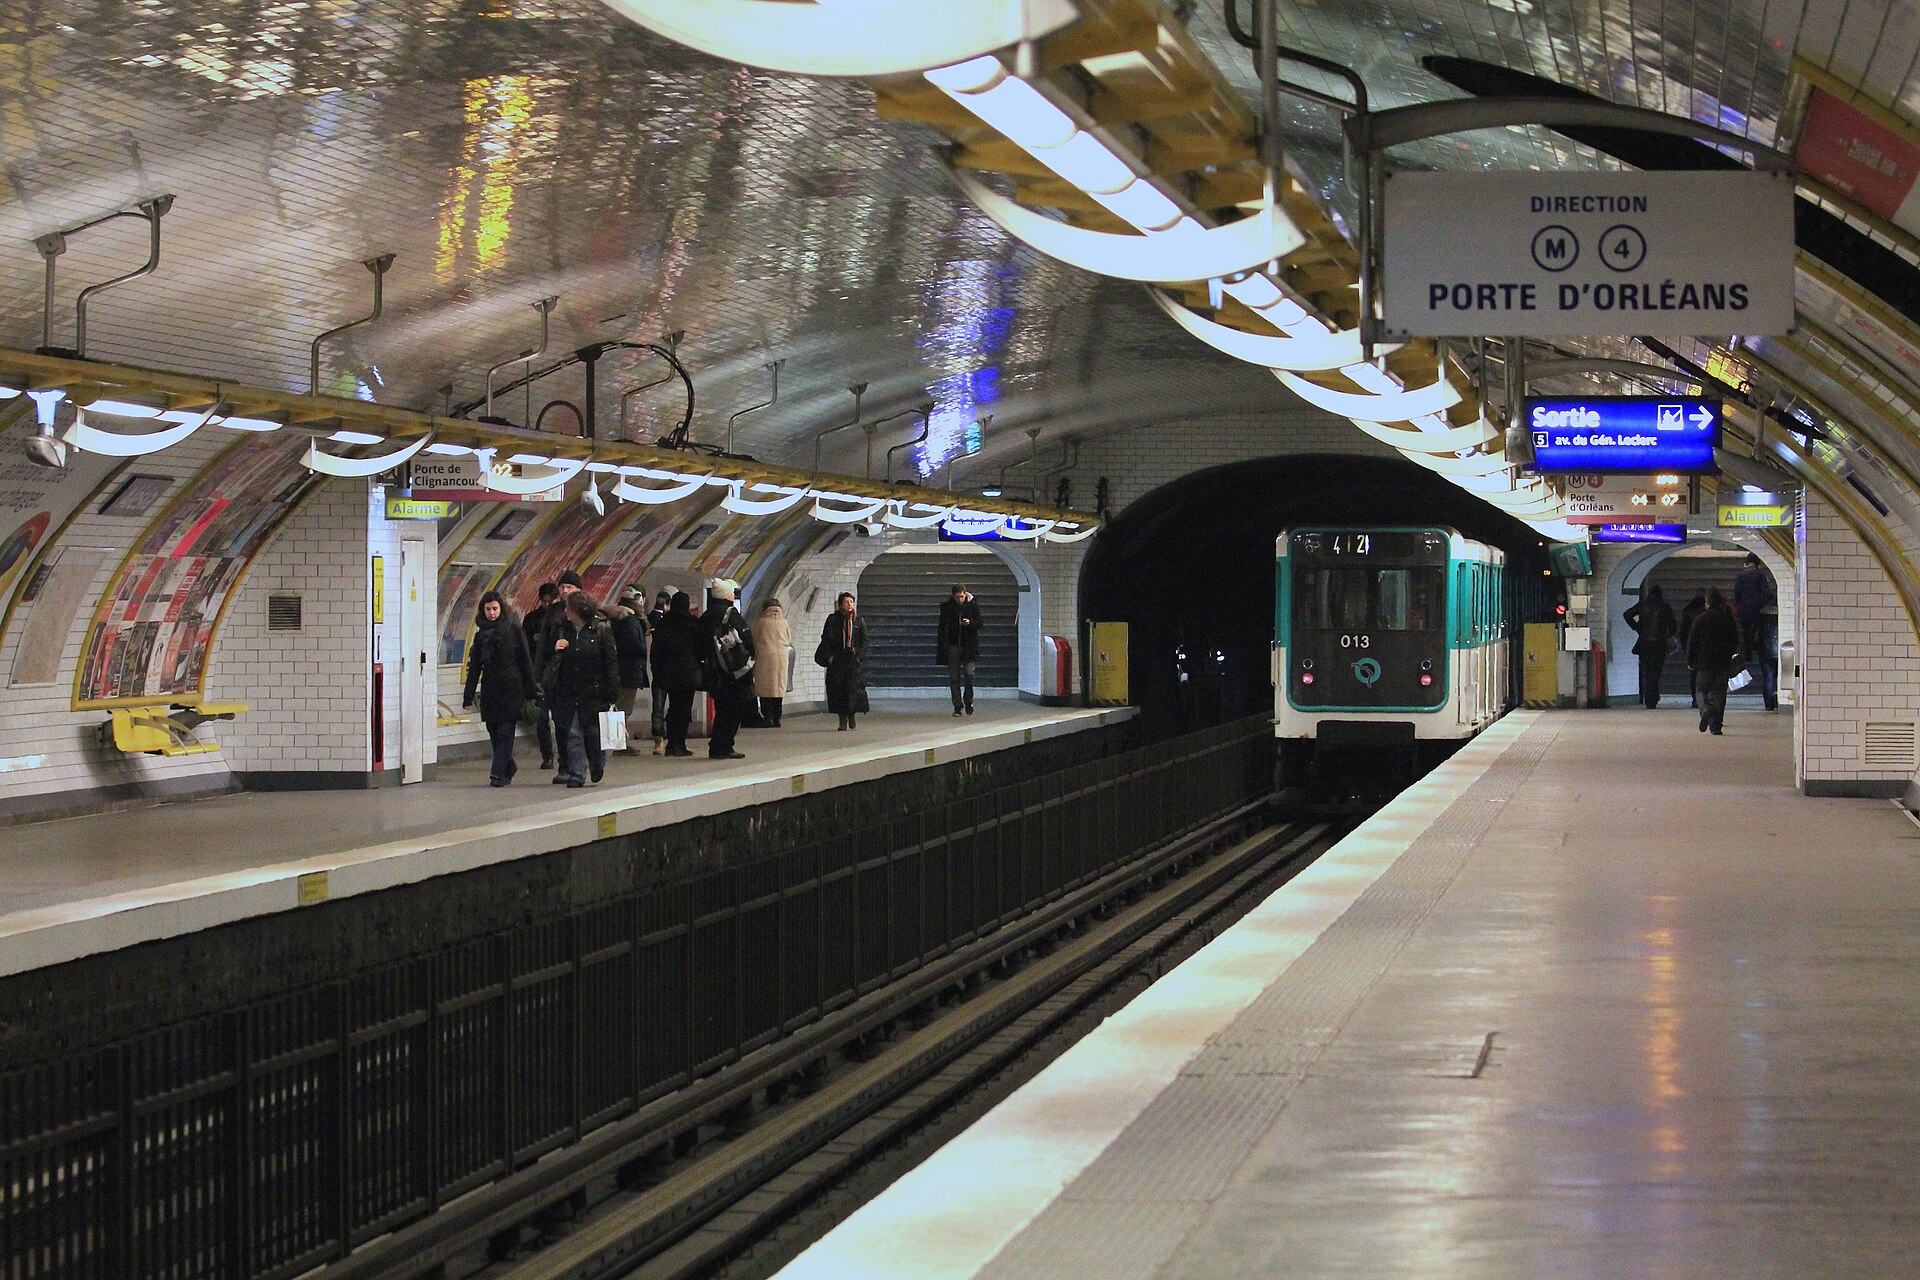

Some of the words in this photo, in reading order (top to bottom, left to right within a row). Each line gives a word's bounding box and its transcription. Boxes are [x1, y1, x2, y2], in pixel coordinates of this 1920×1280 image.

[1531, 196, 1648, 213] DIRECTION
[1613, 240, 1630, 259] 4
[1430, 284, 1536, 310] PORTE
[1558, 279, 1748, 310] D'ORLÉANS
[1532, 406, 1600, 427] Sortie
[1555, 437, 1571, 446] av.
[1573, 435, 1588, 446] du
[1590, 434, 1616, 446] Gén.
[1618, 434, 1657, 446] Leclerc
[415, 464, 445, 474] Porte
[447, 464, 461, 474] de
[491, 463, 513, 477] 02
[1570, 494, 1595, 502] Porte
[1631, 494, 1648, 506] 04
[1661, 494, 1679, 506] 07
[393, 502, 441, 514] Alarme
[1570, 503, 1614, 512] d'Orléans
[1725, 510, 1773, 522] Alarme
[1341, 635, 1370, 648] 013
